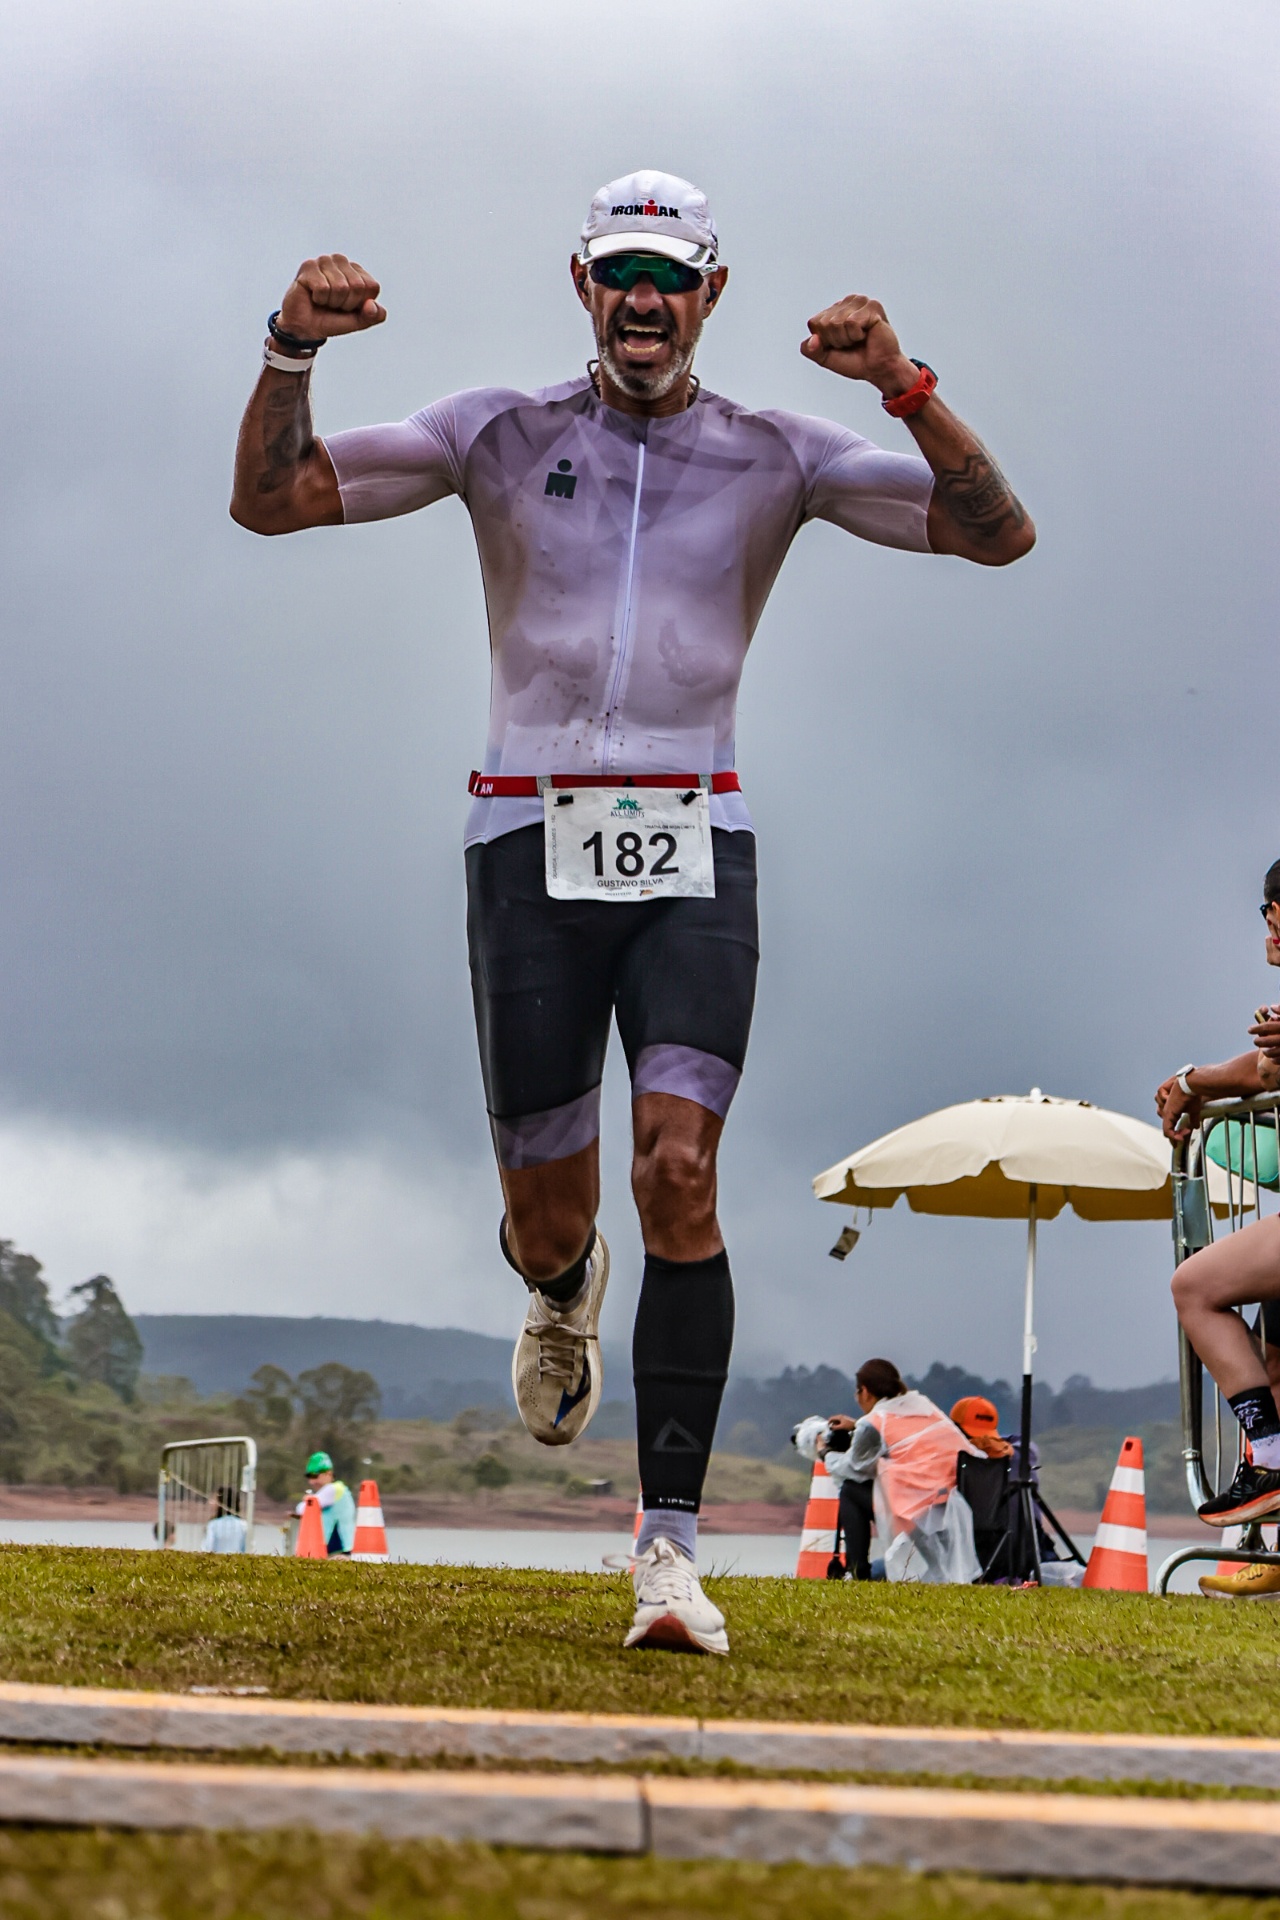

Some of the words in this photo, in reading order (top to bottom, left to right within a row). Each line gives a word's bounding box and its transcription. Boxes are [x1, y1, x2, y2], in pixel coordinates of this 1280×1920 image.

[611, 199, 682, 219] IRONMAN
[623, 809, 645, 818] LIMITS
[583, 831, 679, 877] 182
[597, 880, 638, 888] GUSTAVO
[640, 877, 664, 887] SILVA
